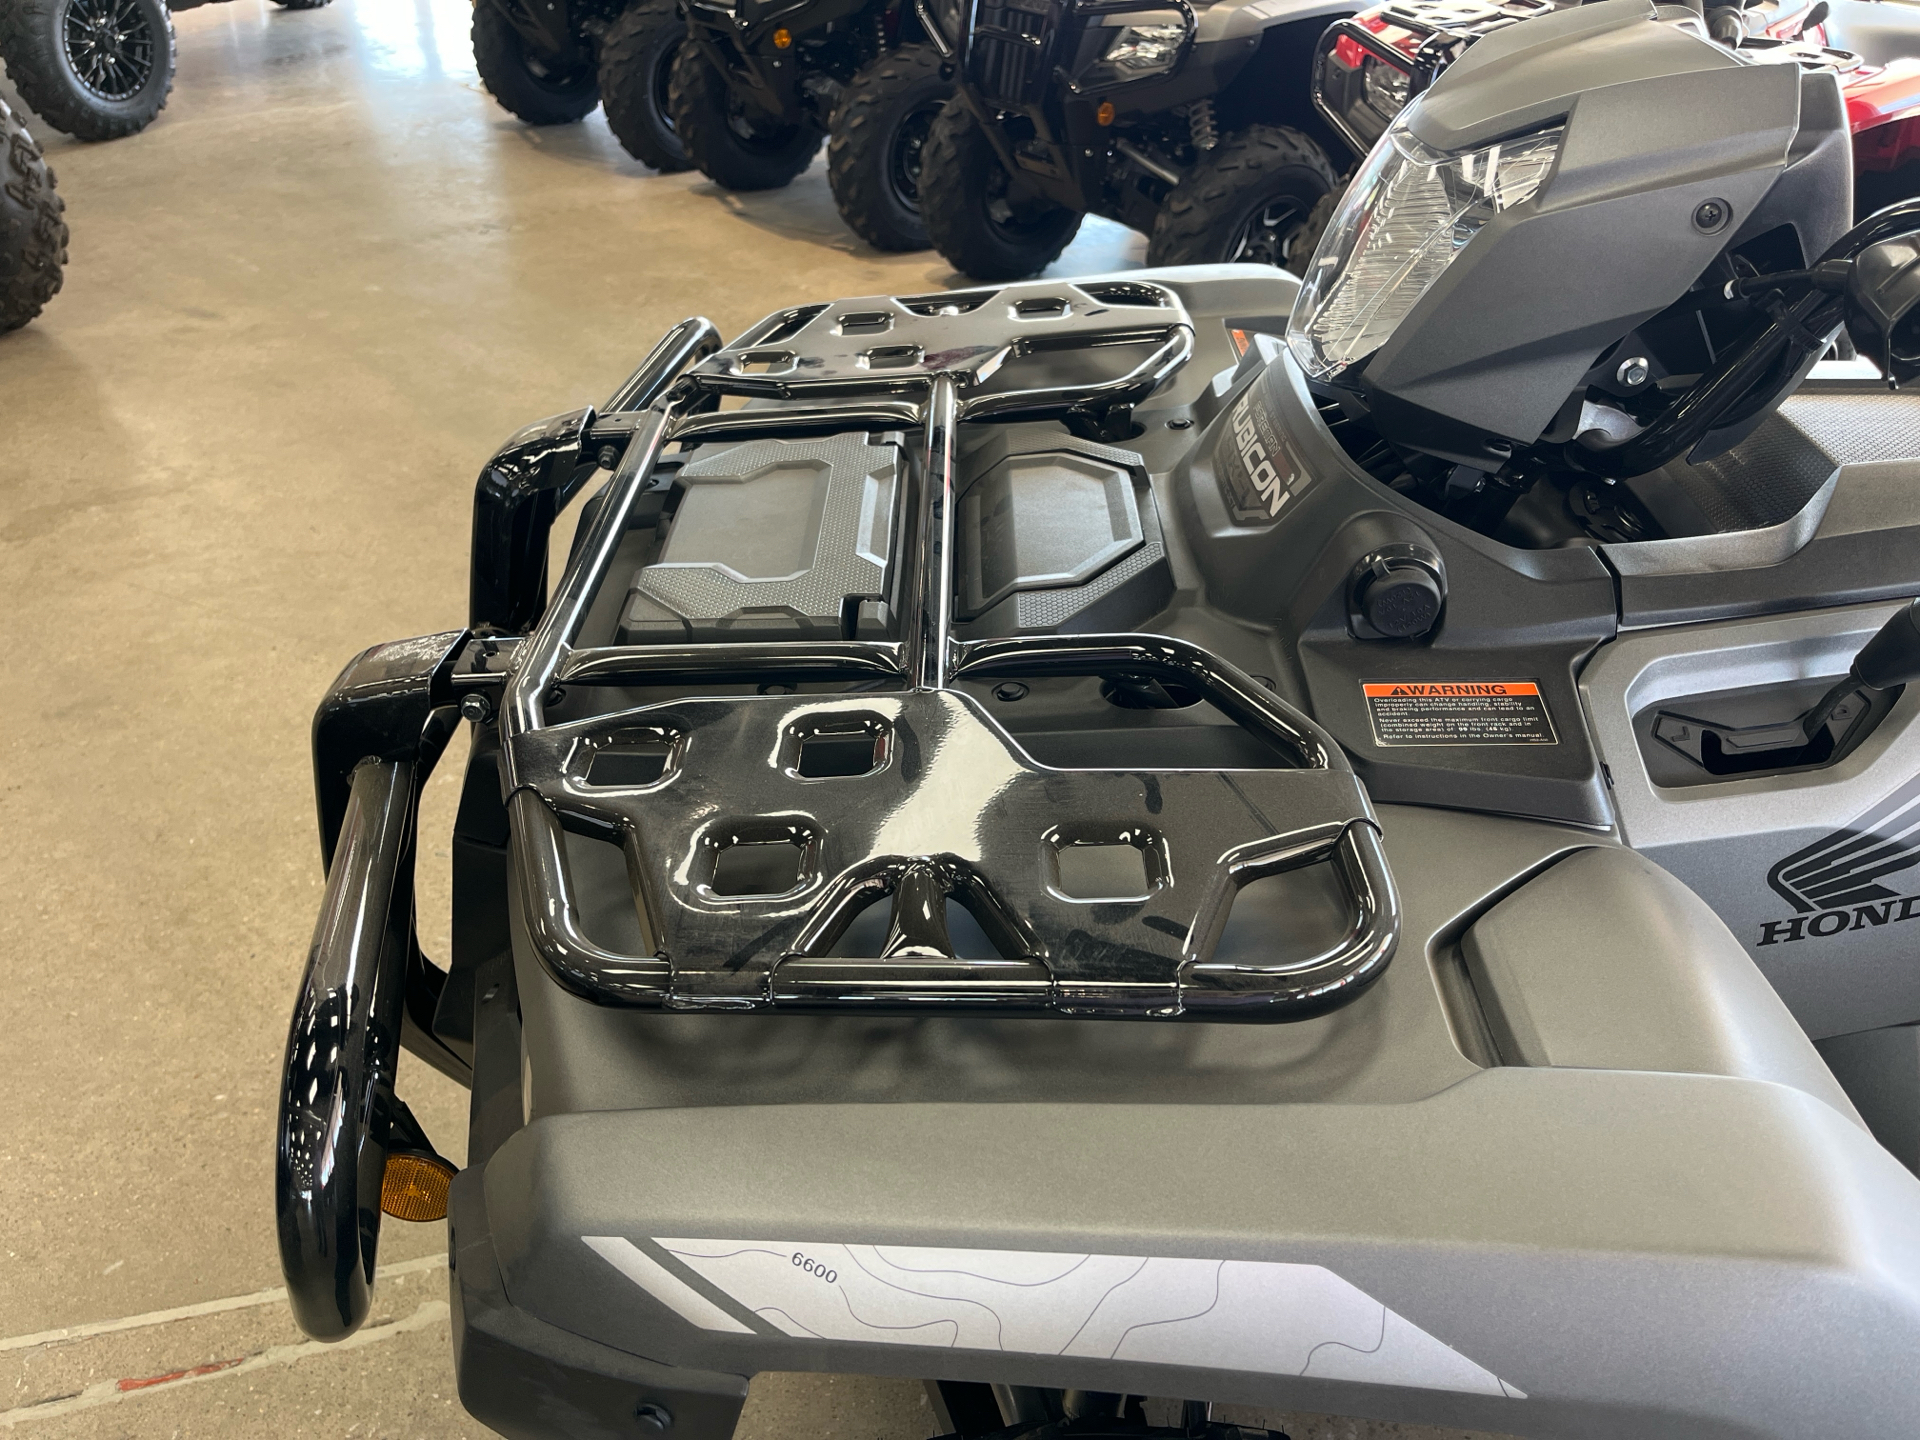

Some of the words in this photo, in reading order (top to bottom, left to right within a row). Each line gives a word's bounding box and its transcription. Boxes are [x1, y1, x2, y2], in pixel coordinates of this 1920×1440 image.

[1253, 400, 1281, 457] FOREMAN
[1232, 393, 1291, 517] RUBICON
[1406, 685, 1507, 695] WARNING
[791, 1252, 838, 1284] 6600
